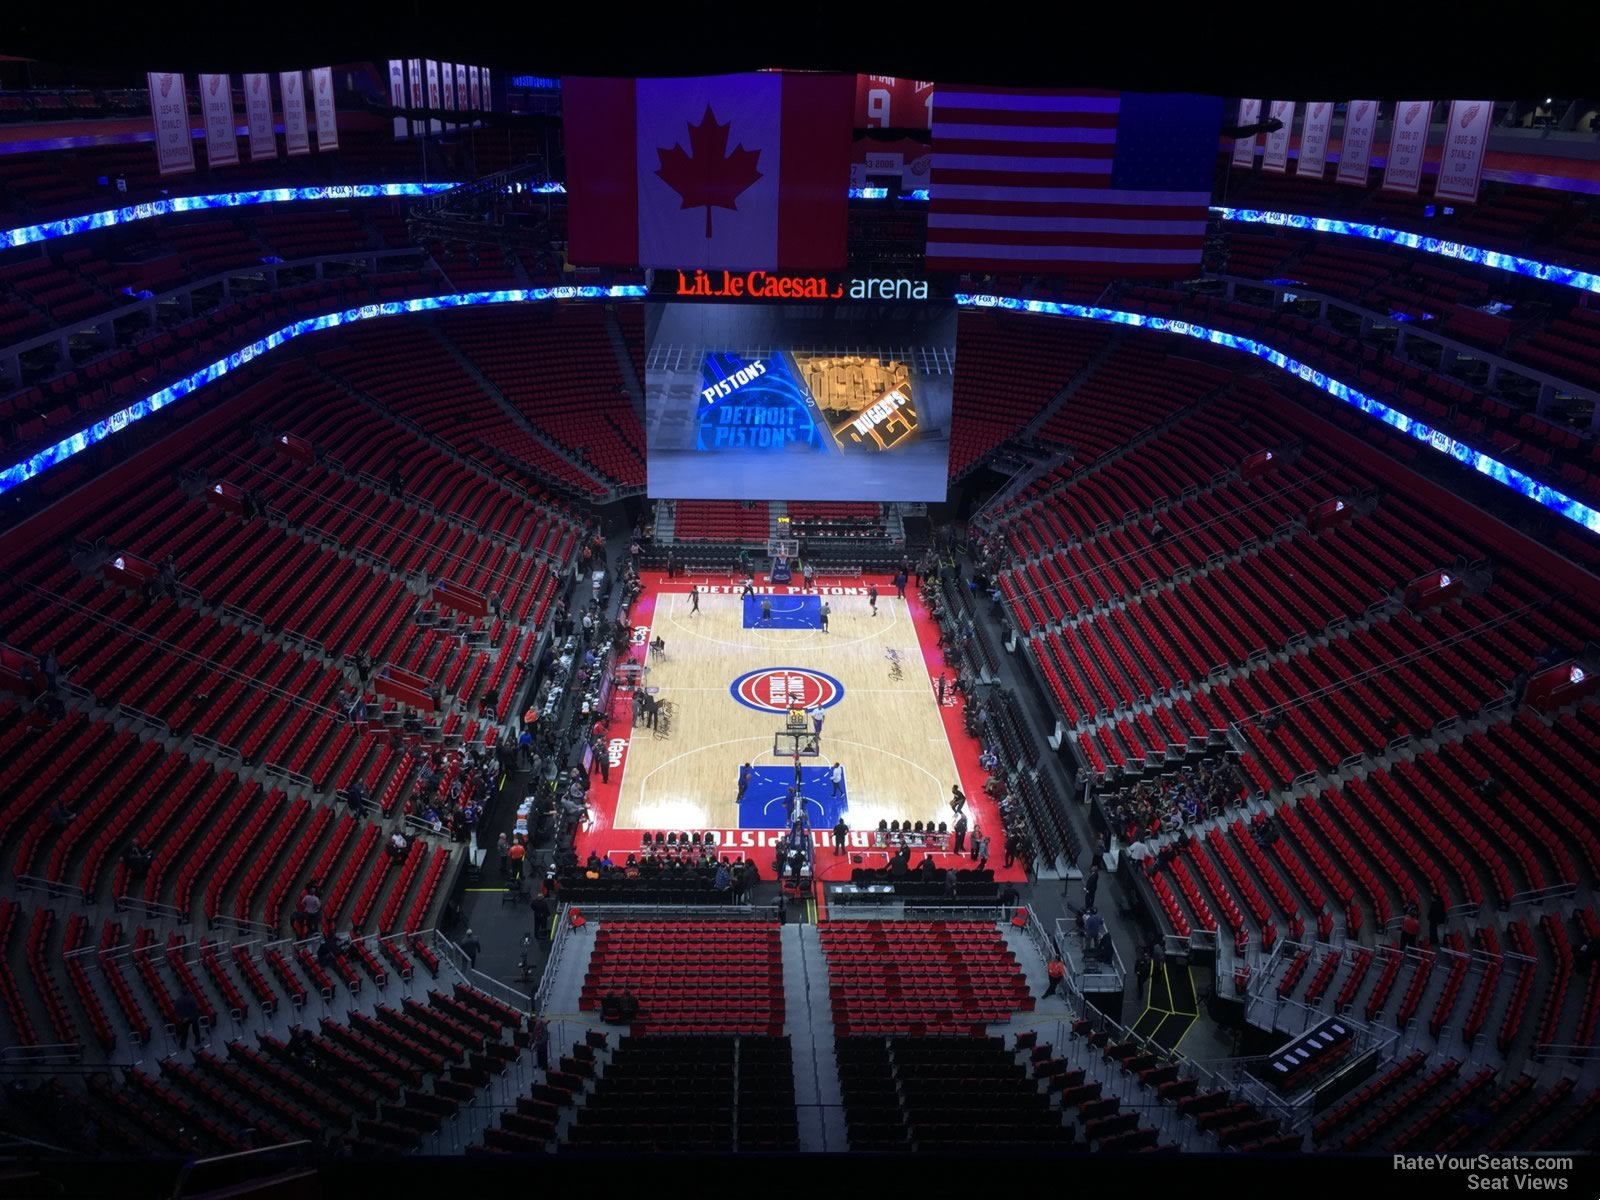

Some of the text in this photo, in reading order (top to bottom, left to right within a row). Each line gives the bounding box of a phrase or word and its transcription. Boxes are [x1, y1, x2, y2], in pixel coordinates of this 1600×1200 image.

[1450, 149, 1476, 160] STANLEY
[676, 269, 744, 296] Litle
[850, 278, 928, 299] arena
[702, 360, 767, 404] PISTONS
[719, 405, 797, 425] DETROIT
[852, 390, 906, 436] NUGGETS
[714, 426, 797, 449] PISTONS
[769, 675, 787, 704] DETROIT
